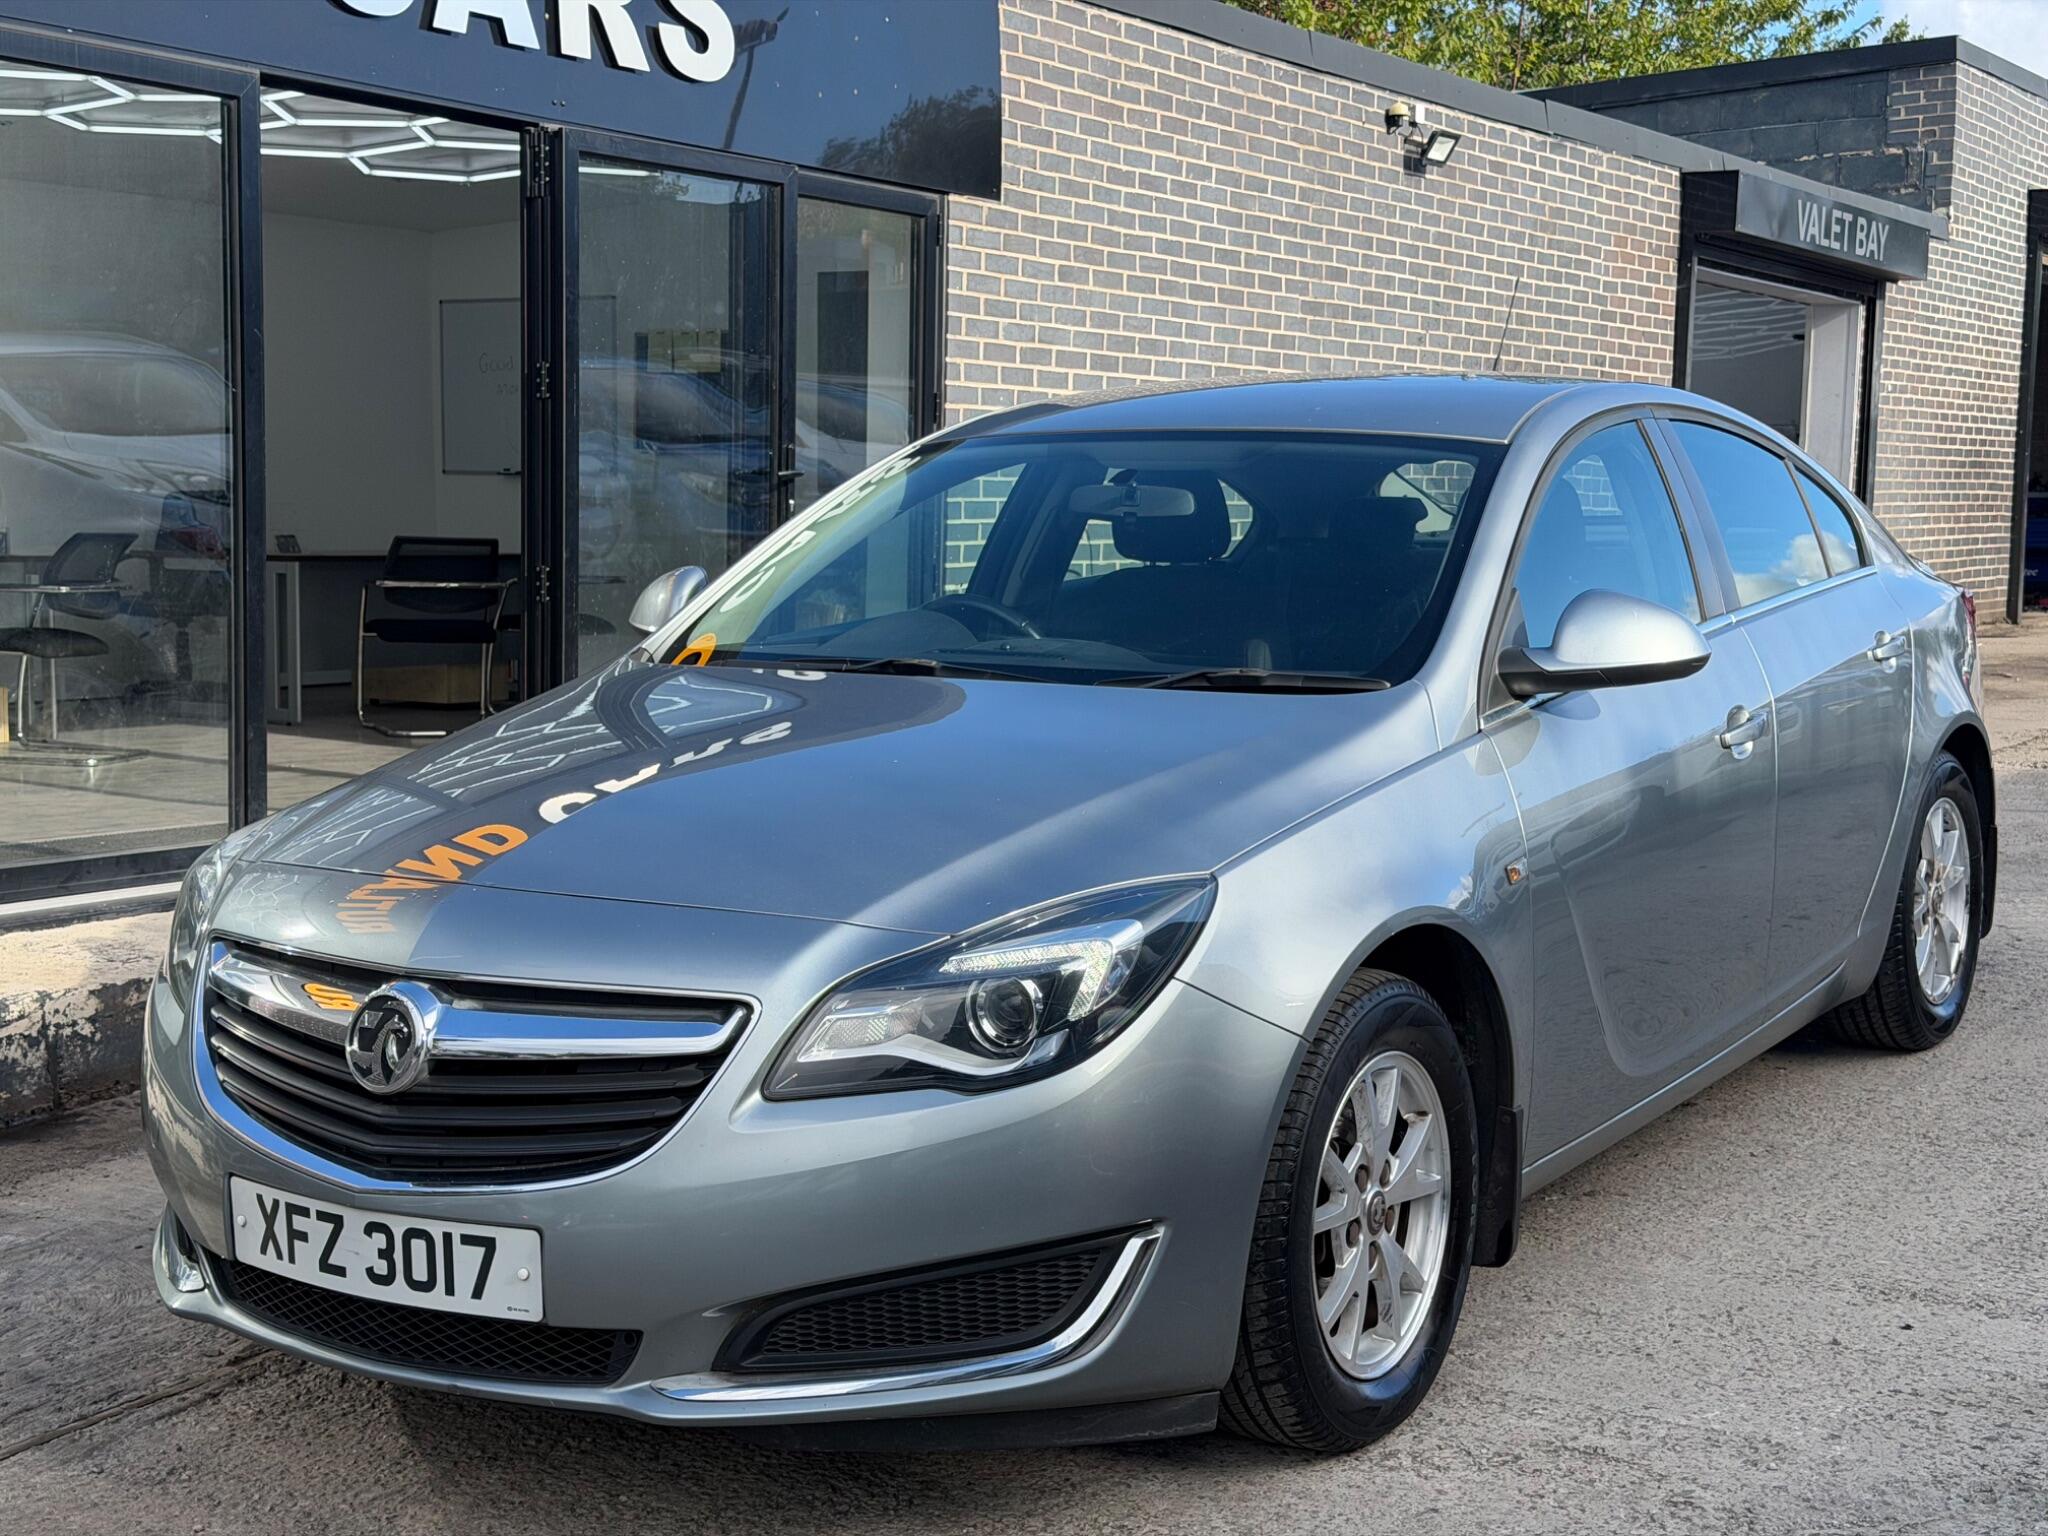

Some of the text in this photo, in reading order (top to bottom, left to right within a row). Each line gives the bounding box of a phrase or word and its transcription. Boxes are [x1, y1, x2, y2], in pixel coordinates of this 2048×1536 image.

[1797, 199, 1889, 262] VALET BAY
[255, 1193, 497, 1300] XFZ 3017
